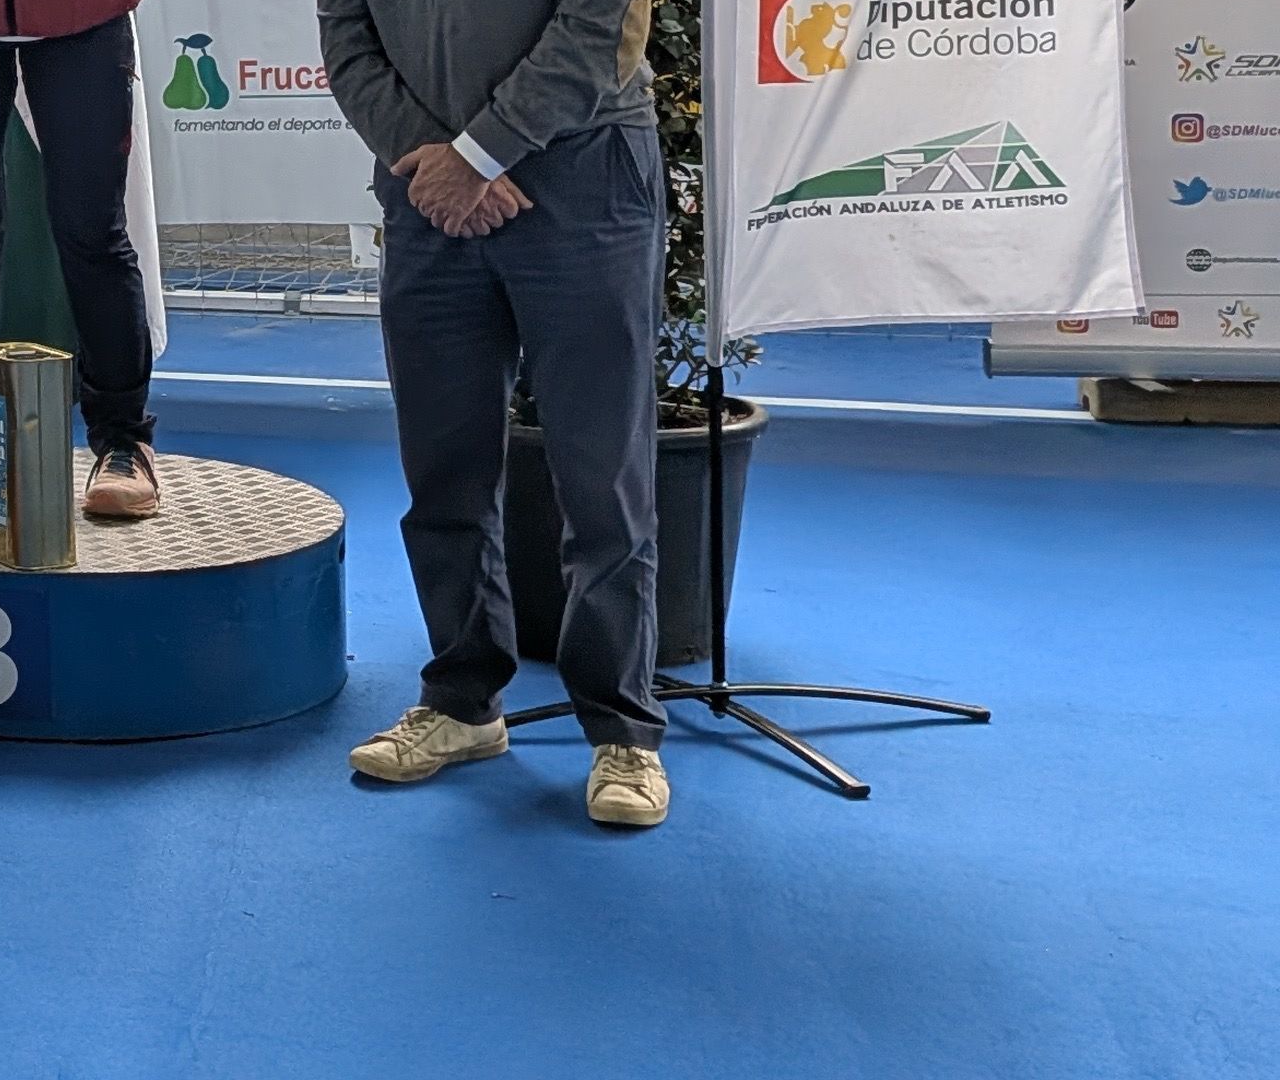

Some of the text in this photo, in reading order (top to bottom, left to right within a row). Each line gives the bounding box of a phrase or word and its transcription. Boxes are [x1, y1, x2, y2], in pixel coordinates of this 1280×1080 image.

[856, 26, 1056, 61] de Córdoba
[239, 60, 329, 90] Fruca
[174, 119, 264, 133] fomentando
[268, 119, 281, 131] el
[285, 118, 342, 134] deporte
[840, 198, 935, 215] ANDALUZA
[942, 197, 964, 210] DE
[972, 193, 1068, 209] ATLETISMO
